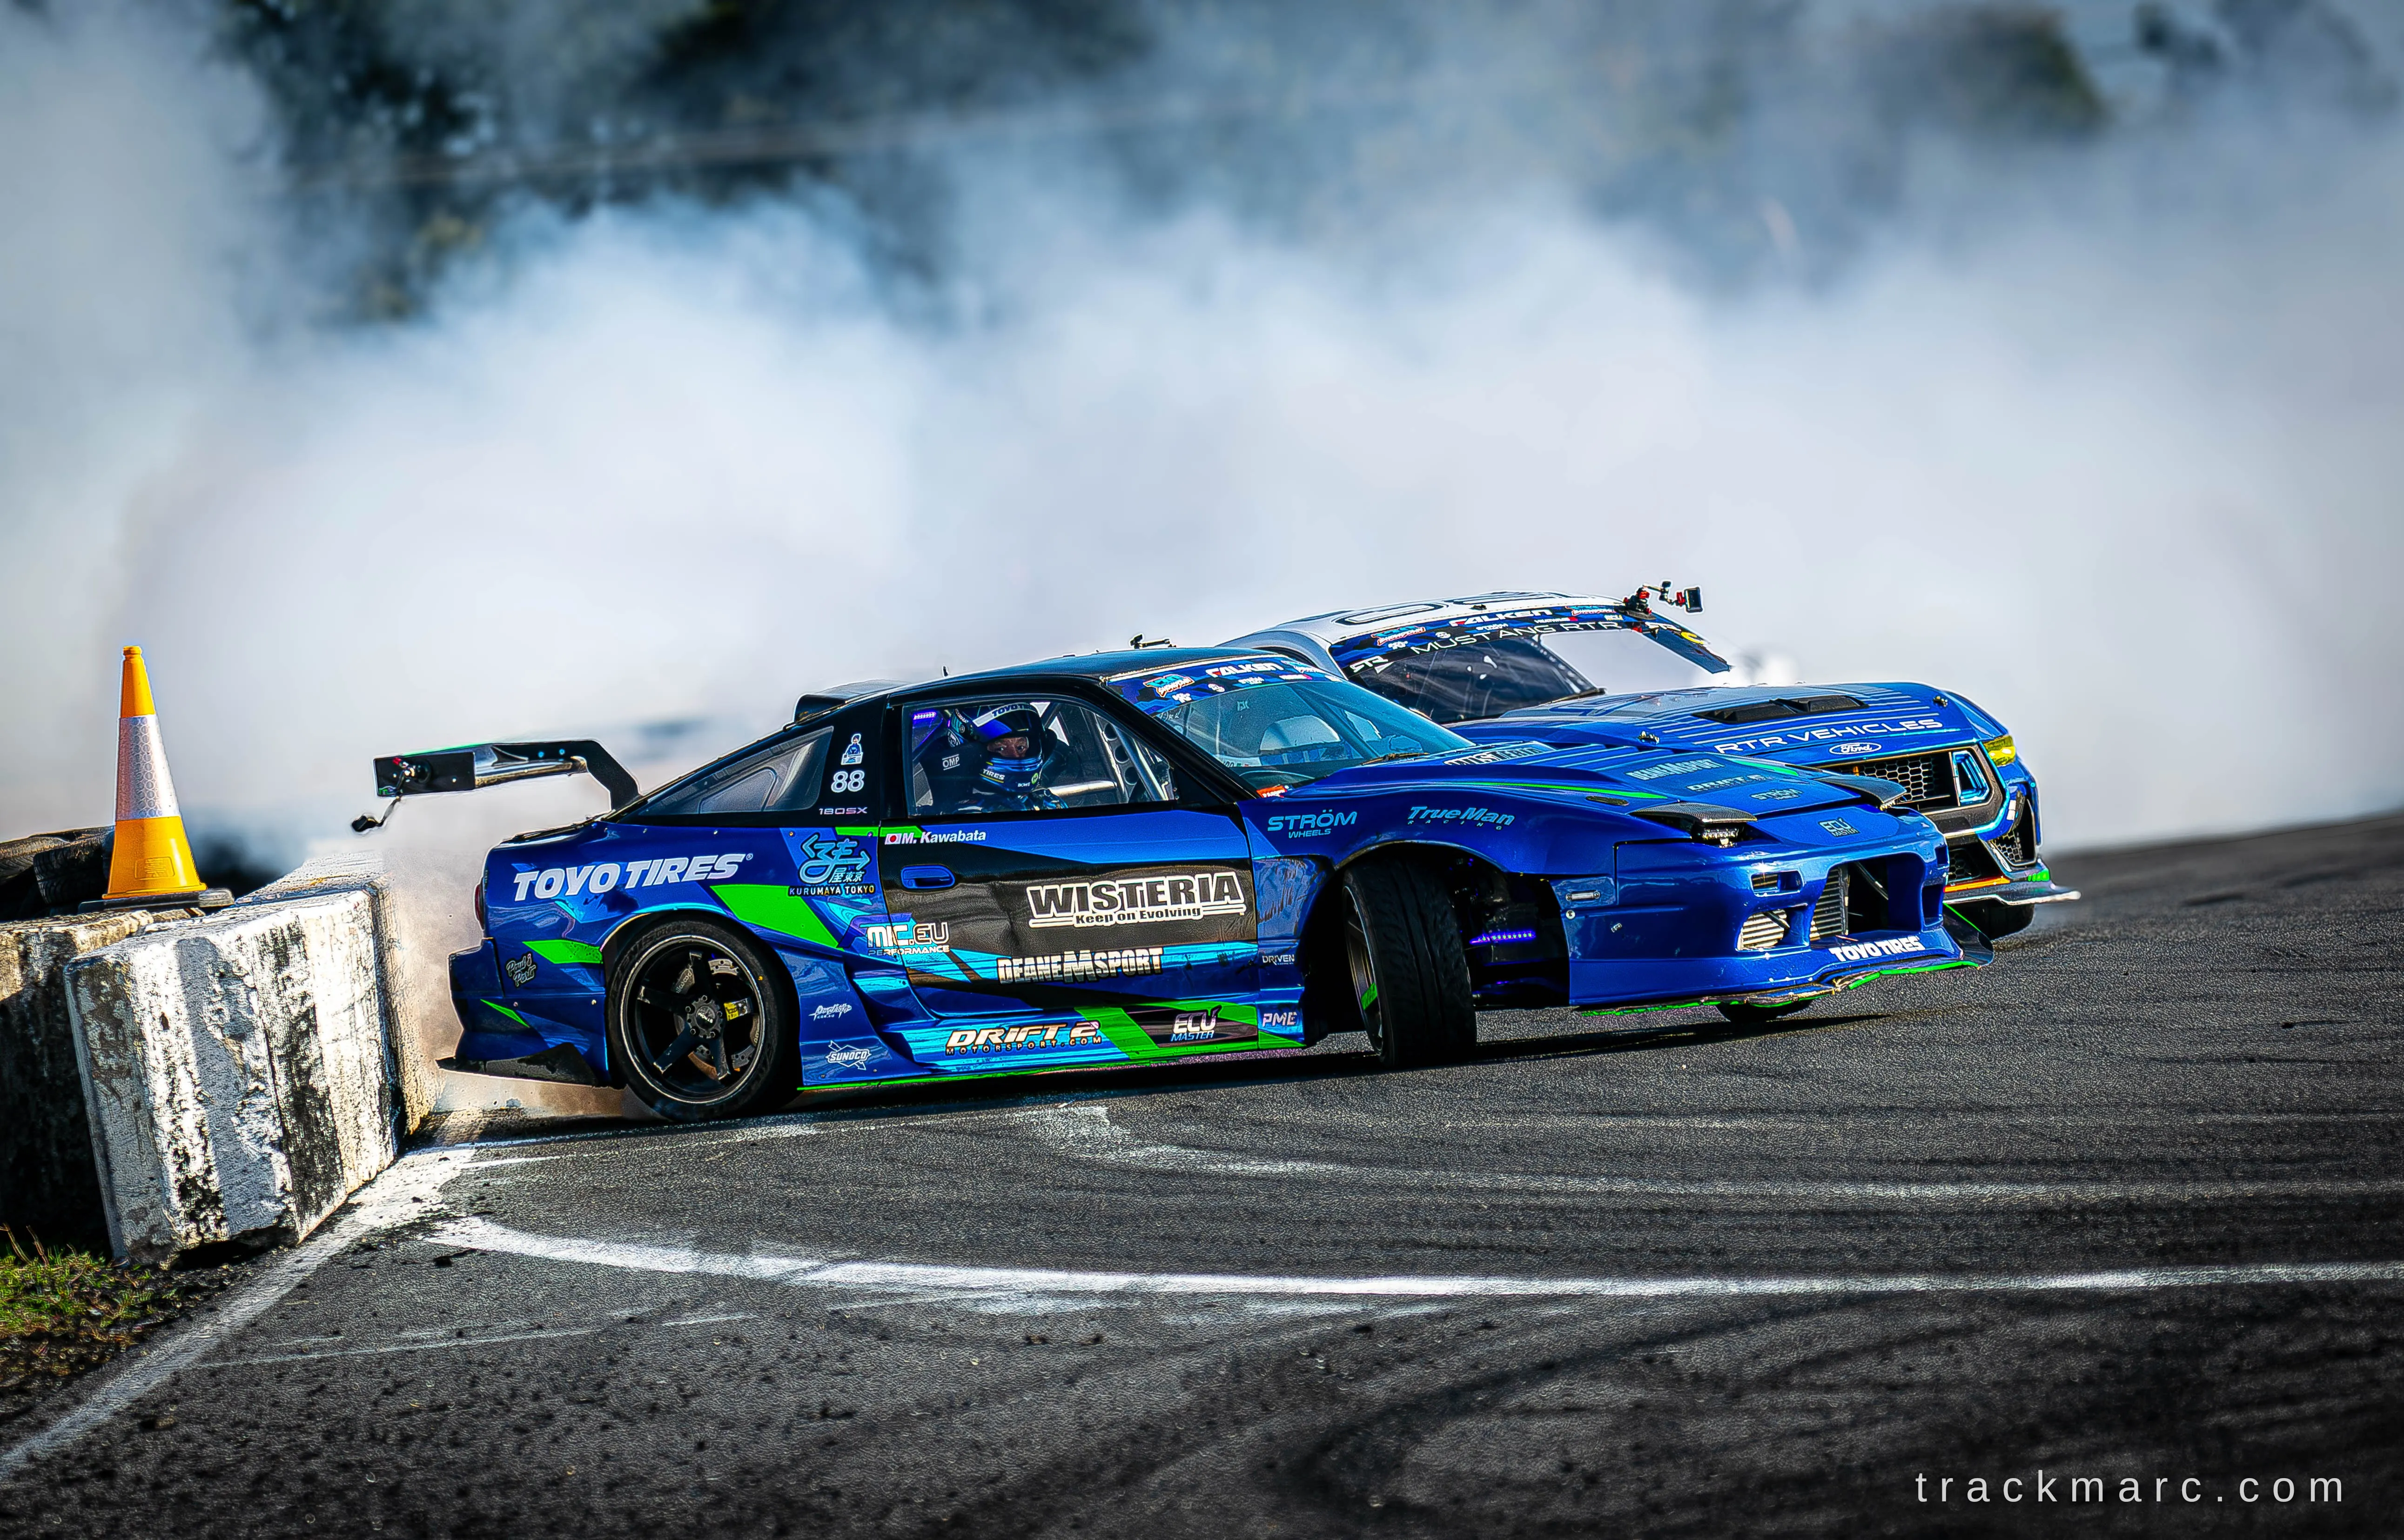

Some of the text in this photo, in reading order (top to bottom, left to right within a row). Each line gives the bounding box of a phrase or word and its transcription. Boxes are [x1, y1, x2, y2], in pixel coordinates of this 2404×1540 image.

[1449, 609, 1553, 627] FALKEN
[1410, 624, 1557, 654] MUSTANG
[1562, 621, 1622, 631] RTR
[1205, 663, 1284, 677] FALKEN
[992, 703, 1019, 717] TOYO
[1714, 718, 1943, 754] RTR VEHICLES
[1841, 743, 1873, 753] Ford
[942, 756, 960, 768] OMP
[982, 768, 1006, 780] TIRES
[831, 770, 865, 793] 88
[1687, 776, 1746, 790] DRIFT
[1751, 789, 1803, 800] STRÖM
[819, 806, 868, 816] 180SX
[1267, 810, 1358, 832] STRÖM
[1407, 819, 1503, 830] RACING
[1820, 818, 1852, 832] ECU
[901, 829, 987, 844] M. Kawabata
[1288, 828, 1331, 838] WHEELS
[1831, 828, 1859, 837] MASTER
[513, 863, 620, 901] TOYO
[790, 885, 874, 896] KURUMAYA TOKYO
[1027, 872, 1243, 918] WISTERIA
[1075, 907, 1201, 925] Keep on Evolving
[868, 944, 950, 956] PERFORMANCE
[1828, 935, 1926, 962] TOYO TIRES
[1262, 954, 1295, 965] DRIVEN
[1173, 1005, 1222, 1033] ECU
[1262, 1011, 1297, 1027] PME
[946, 1023, 1068, 1047] DRIFT
[1171, 1030, 1214, 1042] MASTER
[946, 1037, 1101, 1055] MOTORSPORT.COM
[830, 1050, 868, 1062] SUNOCO
